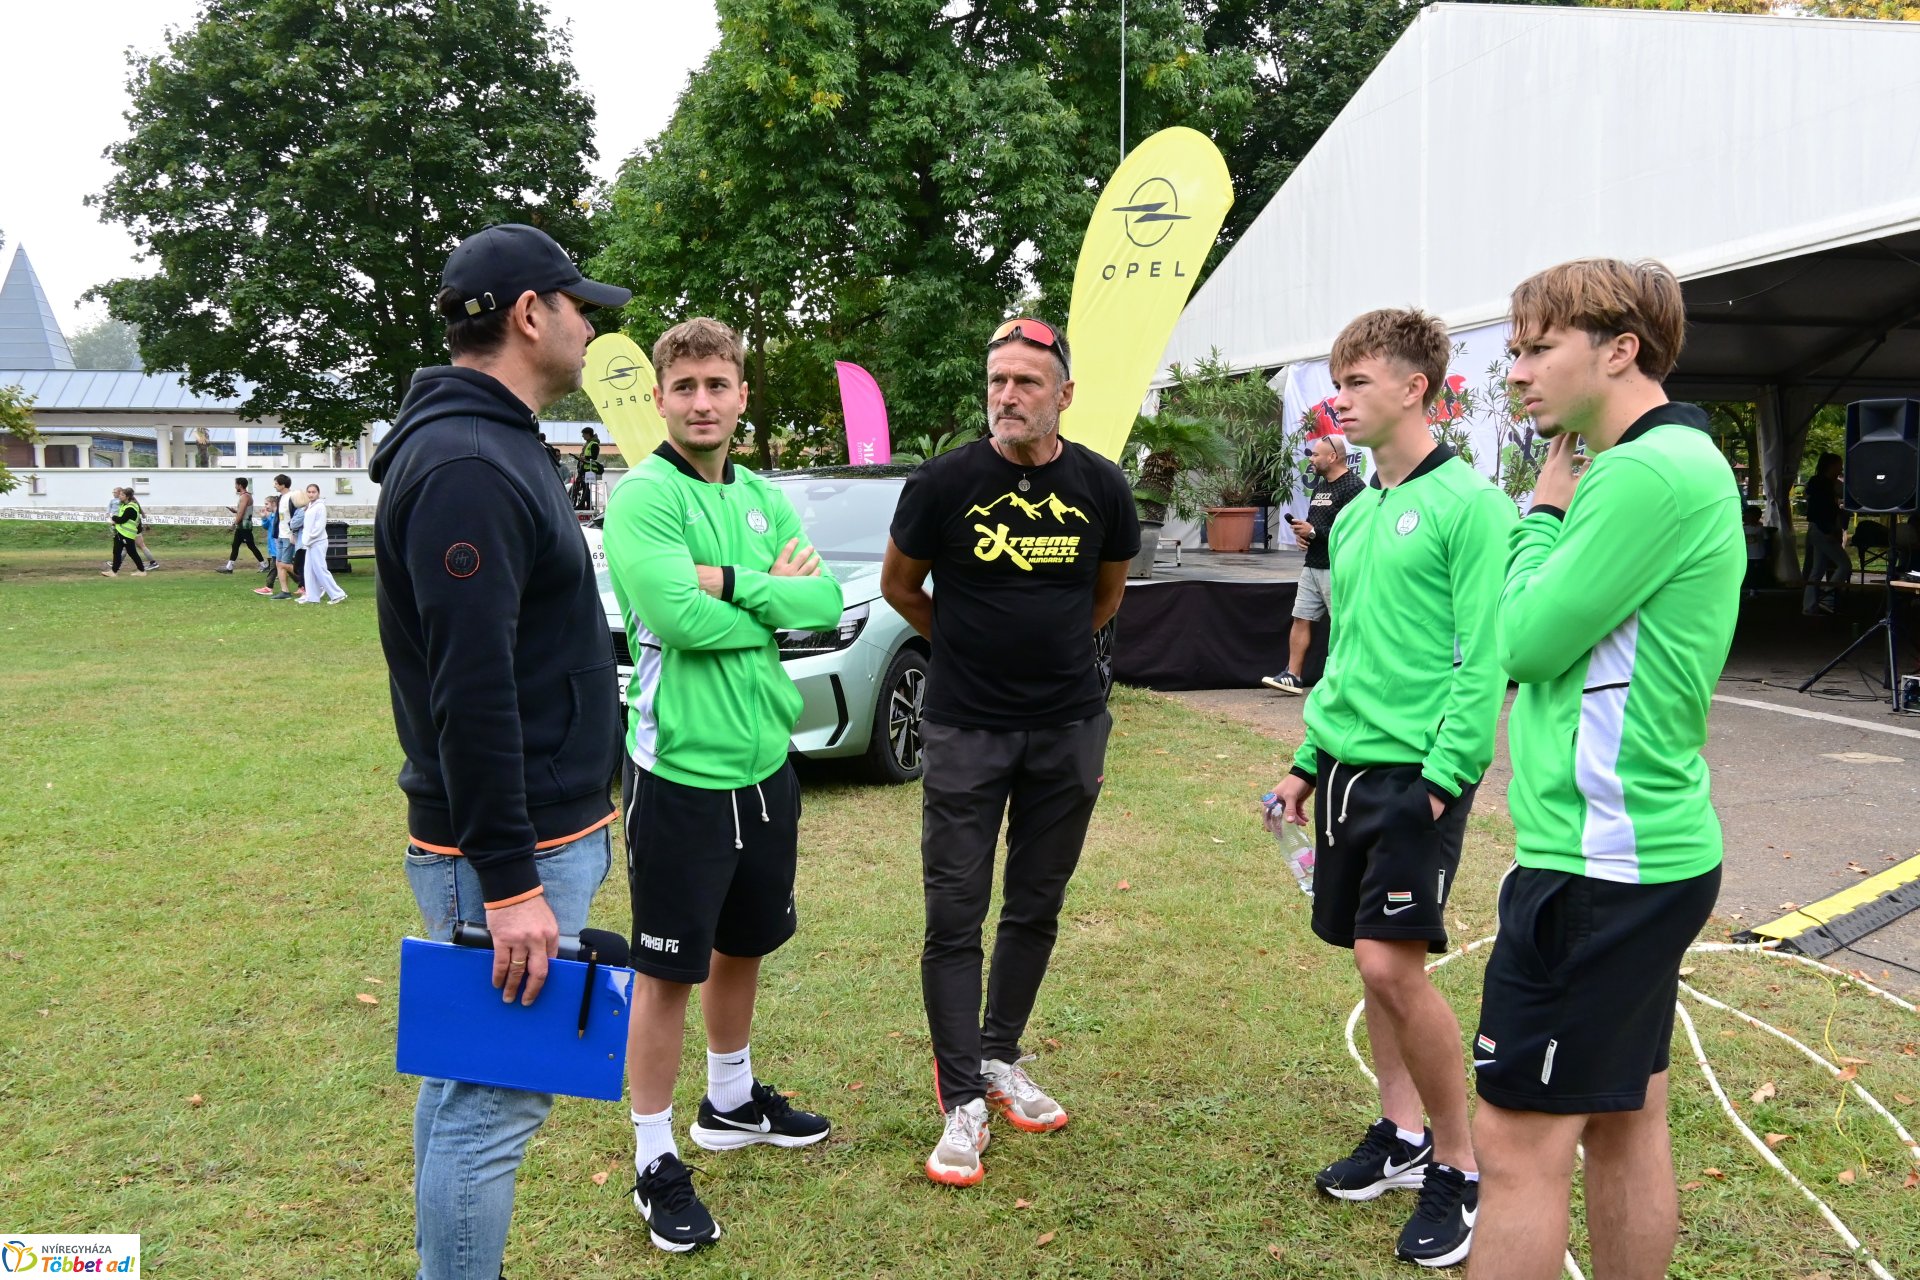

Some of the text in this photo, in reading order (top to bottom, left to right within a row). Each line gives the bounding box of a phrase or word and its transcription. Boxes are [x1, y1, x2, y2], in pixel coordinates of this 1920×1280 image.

[1102, 261, 1186, 280] OPEL
[974, 523, 1081, 571] EXTREME
[1020, 546, 1080, 557] TRAIL
[665, 938, 680, 953] FC
